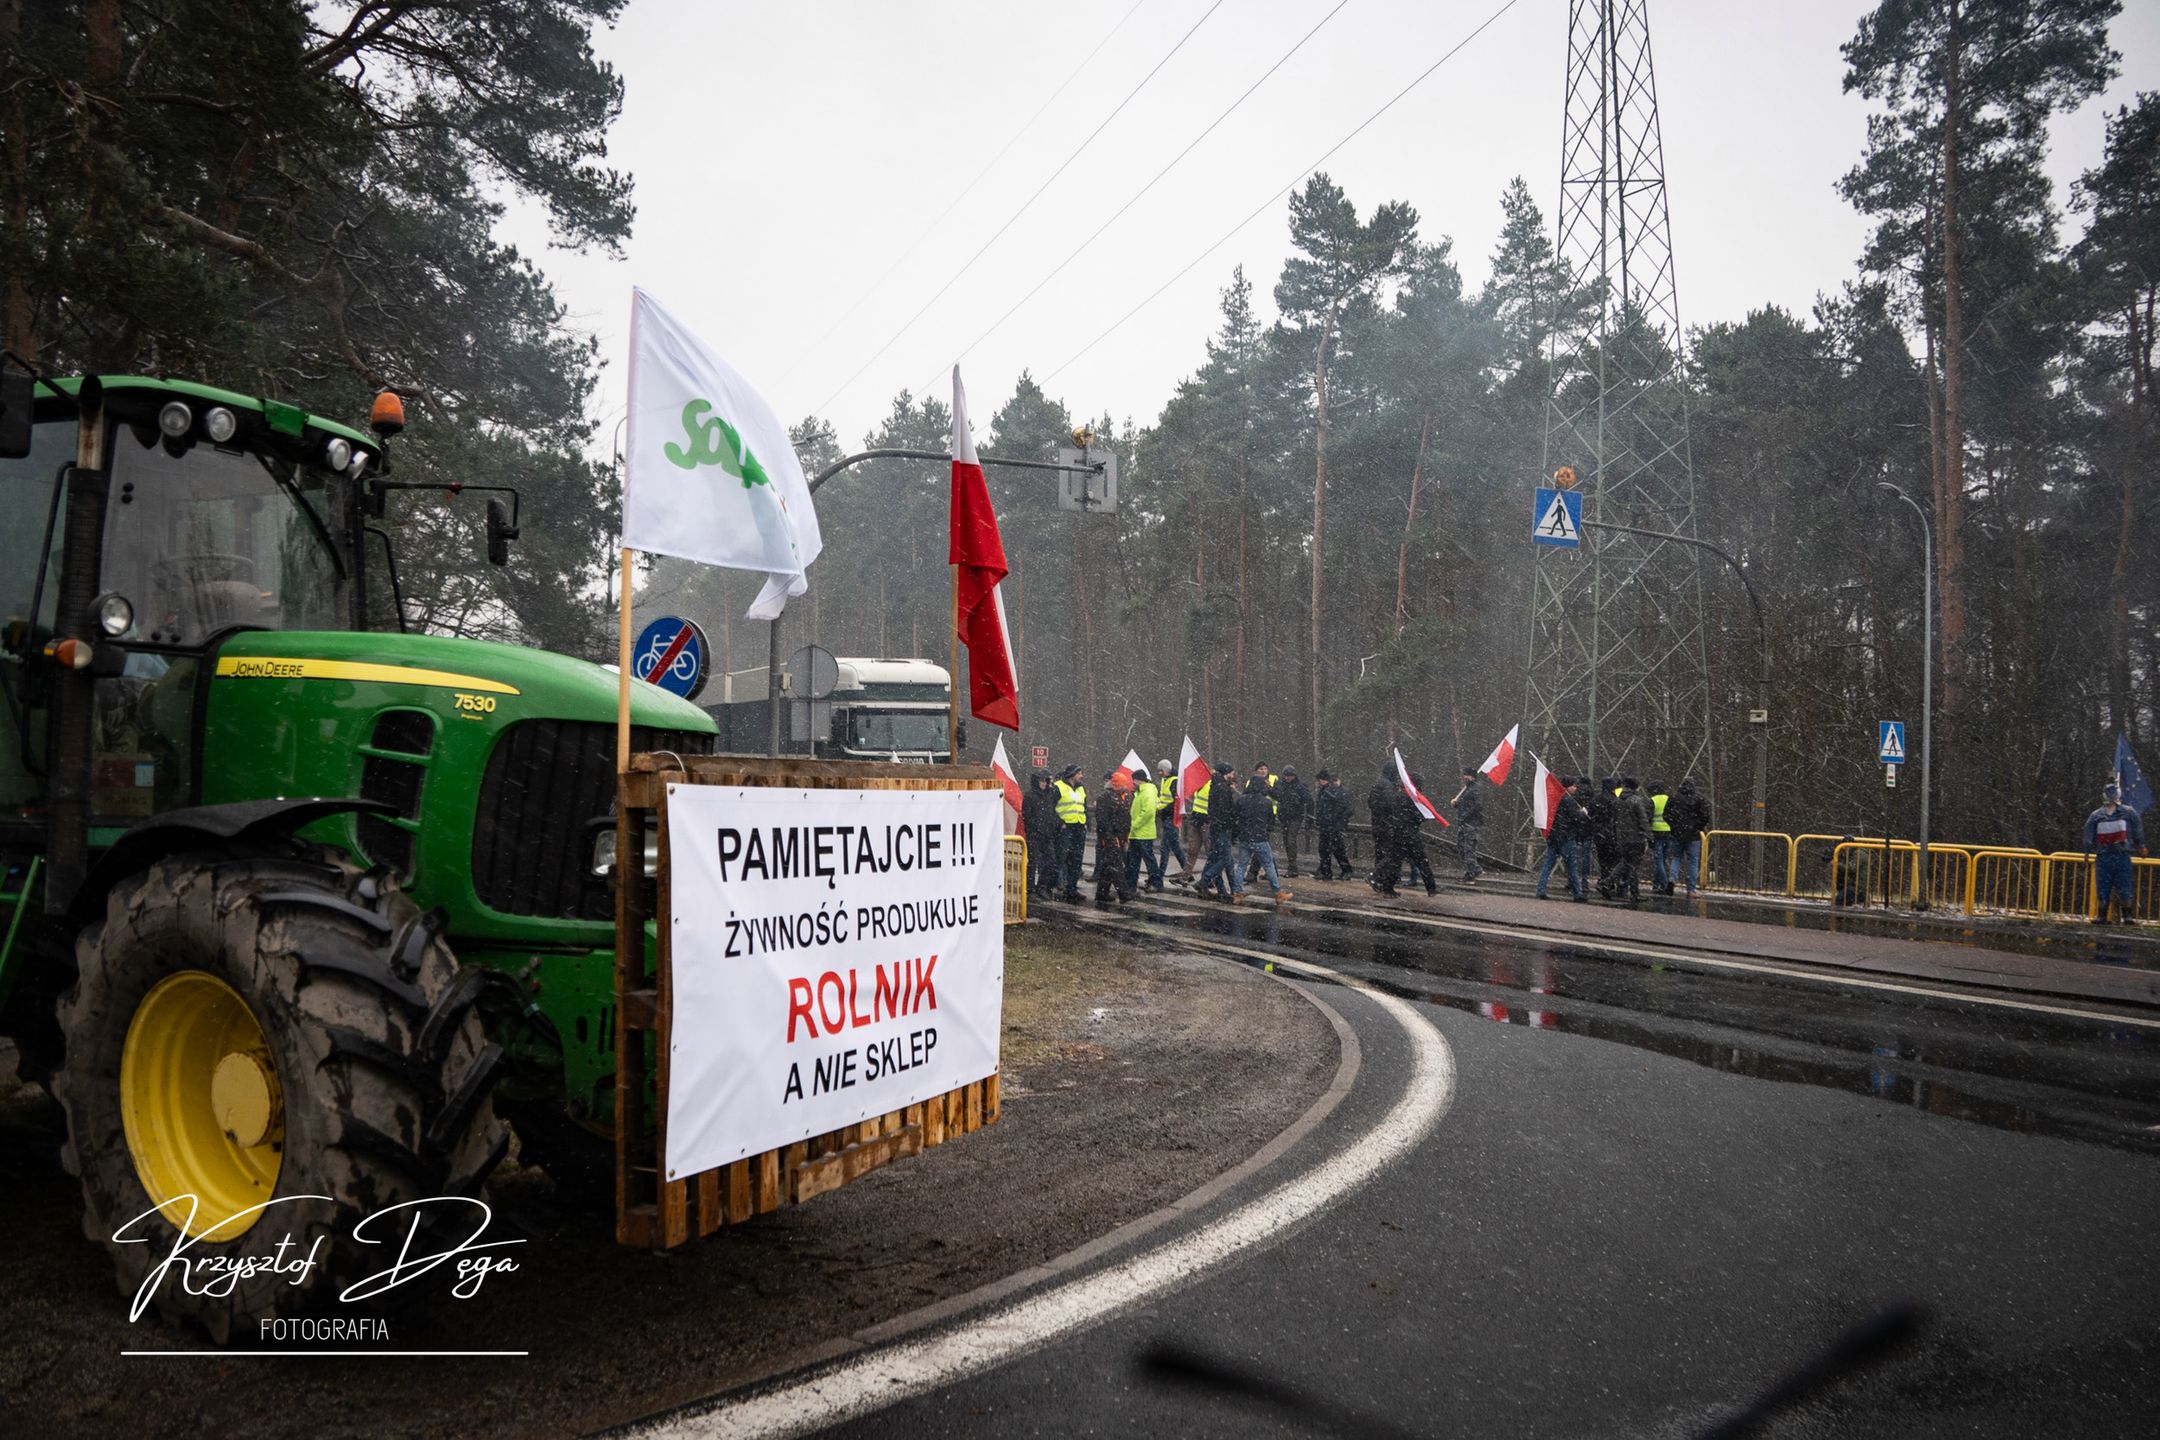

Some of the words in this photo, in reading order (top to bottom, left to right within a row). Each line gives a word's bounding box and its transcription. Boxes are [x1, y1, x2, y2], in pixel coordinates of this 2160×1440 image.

[231, 660, 264, 677] JOHN
[265, 661, 304, 677] DEERE
[453, 693, 496, 713] 7530
[717, 823, 942, 889] PAMIĘTAJCIE
[951, 822, 976, 867] !!!
[724, 900, 849, 959] ŻYWNOŚĆ
[857, 894, 979, 941] PRODUKUJE
[786, 954, 939, 1044] ROLNIK
[783, 1062, 804, 1104] A
[812, 1048, 858, 1097] NIE
[865, 1027, 938, 1083] SKLEP
